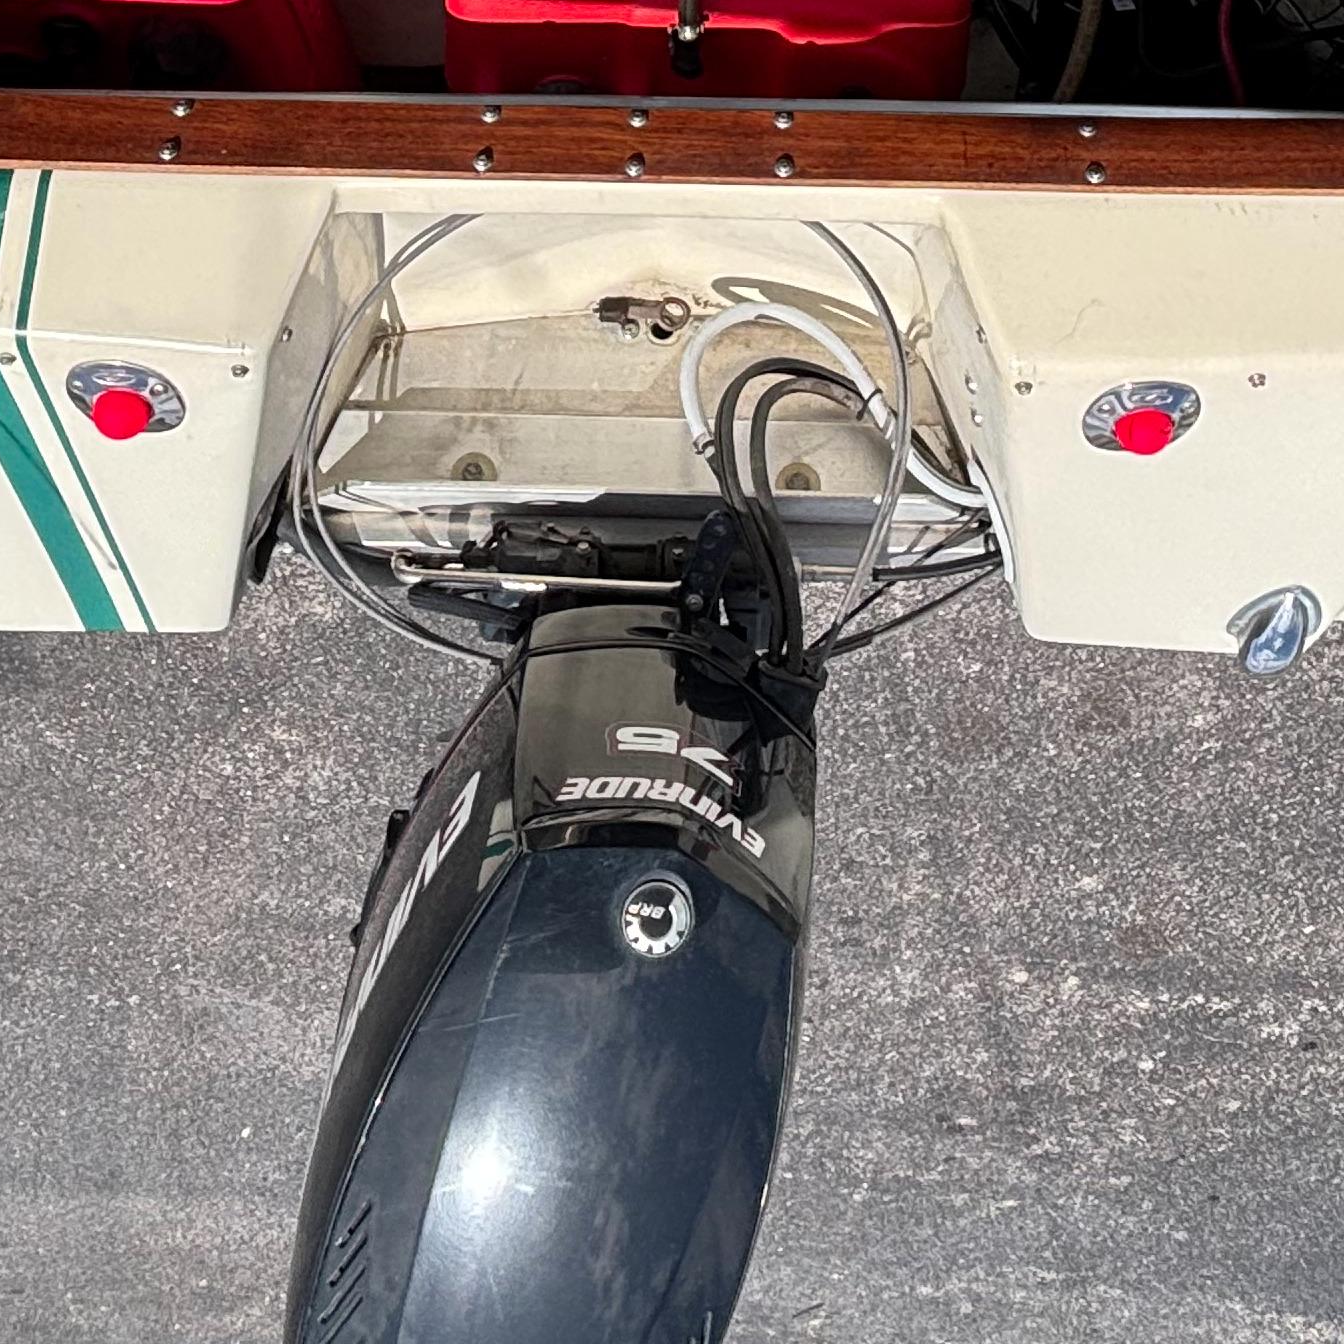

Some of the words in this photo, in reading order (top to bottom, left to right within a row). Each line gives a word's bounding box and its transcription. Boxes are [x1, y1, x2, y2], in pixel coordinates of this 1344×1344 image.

[616, 726, 734, 788] 75
[556, 776, 766, 859] EVINRUDE
[627, 902, 666, 919] BRP
